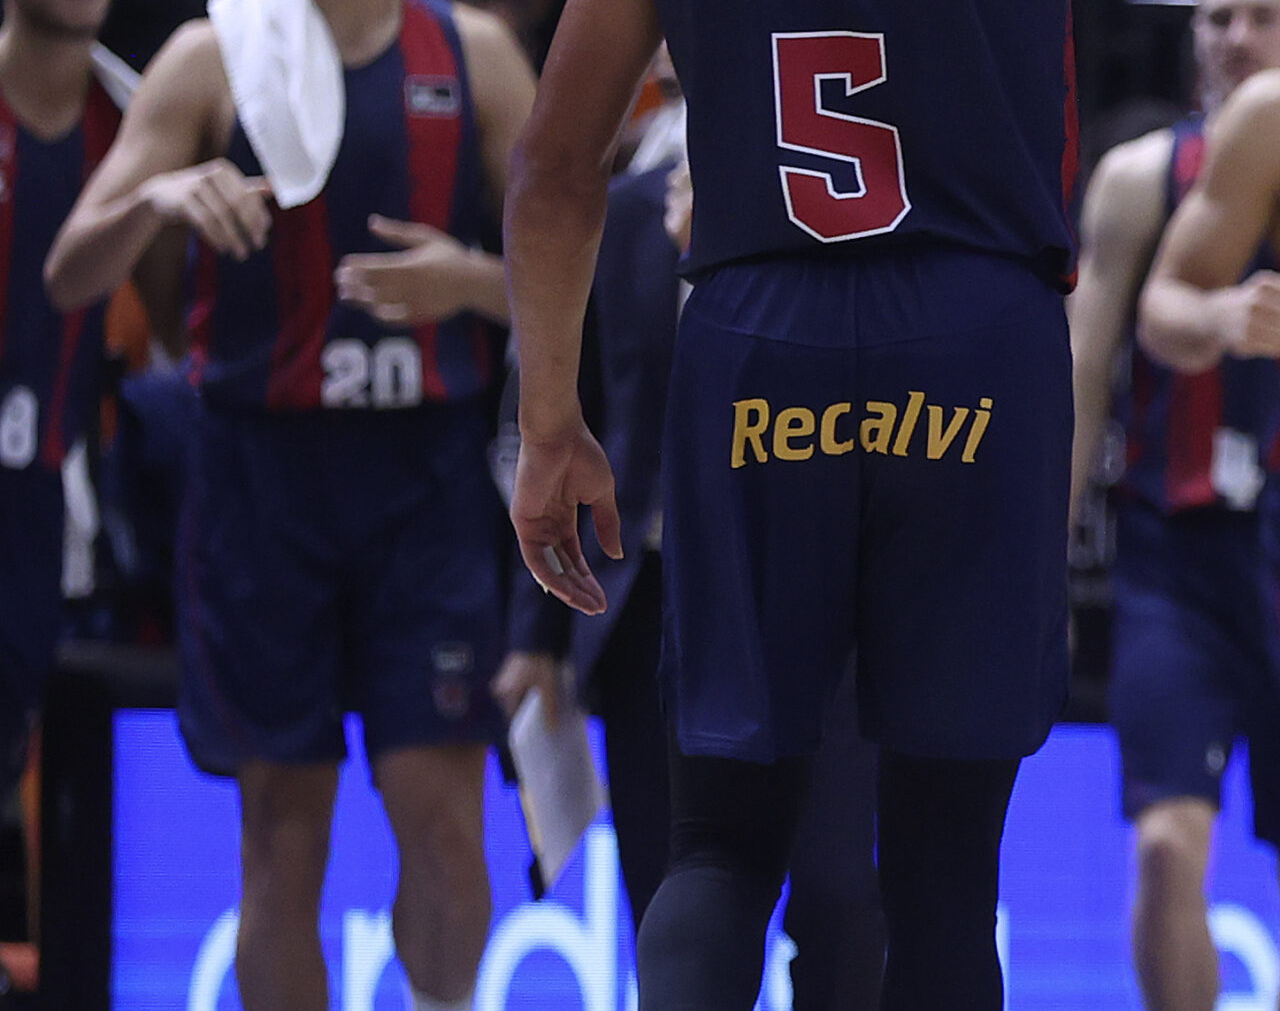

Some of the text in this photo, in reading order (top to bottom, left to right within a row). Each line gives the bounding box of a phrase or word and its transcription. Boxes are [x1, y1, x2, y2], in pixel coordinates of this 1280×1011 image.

[772, 31, 911, 243] 5
[321, 337, 423, 408] 20
[730, 390, 994, 469] Recalvi
